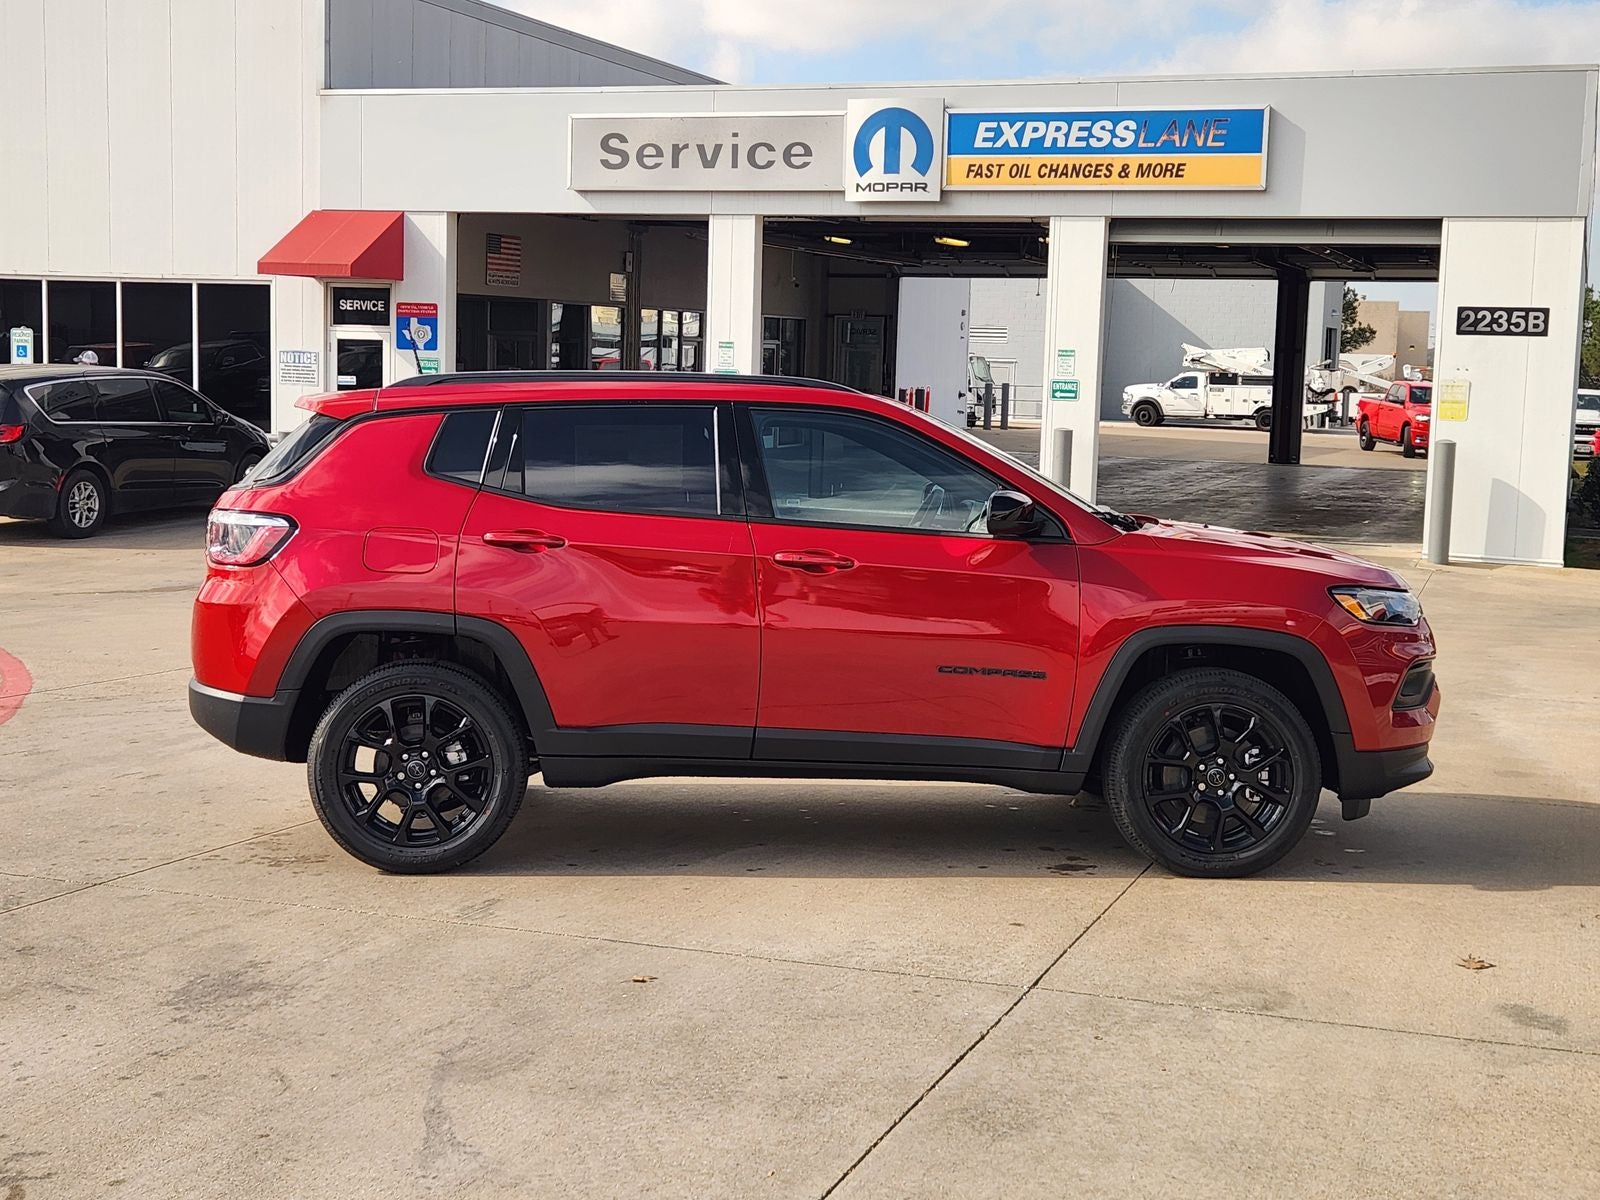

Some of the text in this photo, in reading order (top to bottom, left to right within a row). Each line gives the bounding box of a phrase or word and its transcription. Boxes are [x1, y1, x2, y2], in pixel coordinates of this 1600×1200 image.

[974, 117, 1230, 148] EXPRESSLANE
[600, 132, 813, 170] Service
[966, 162, 1186, 178] FAST OIL CHANGES & MORE
[856, 182, 930, 193] MOPAR
[339, 299, 385, 311] SERVICE
[1460, 310, 1545, 333] 2235B
[280, 351, 317, 364] NOTICE
[1053, 382, 1077, 390] ENTRANCE
[938, 666, 1046, 680] COMPASS
